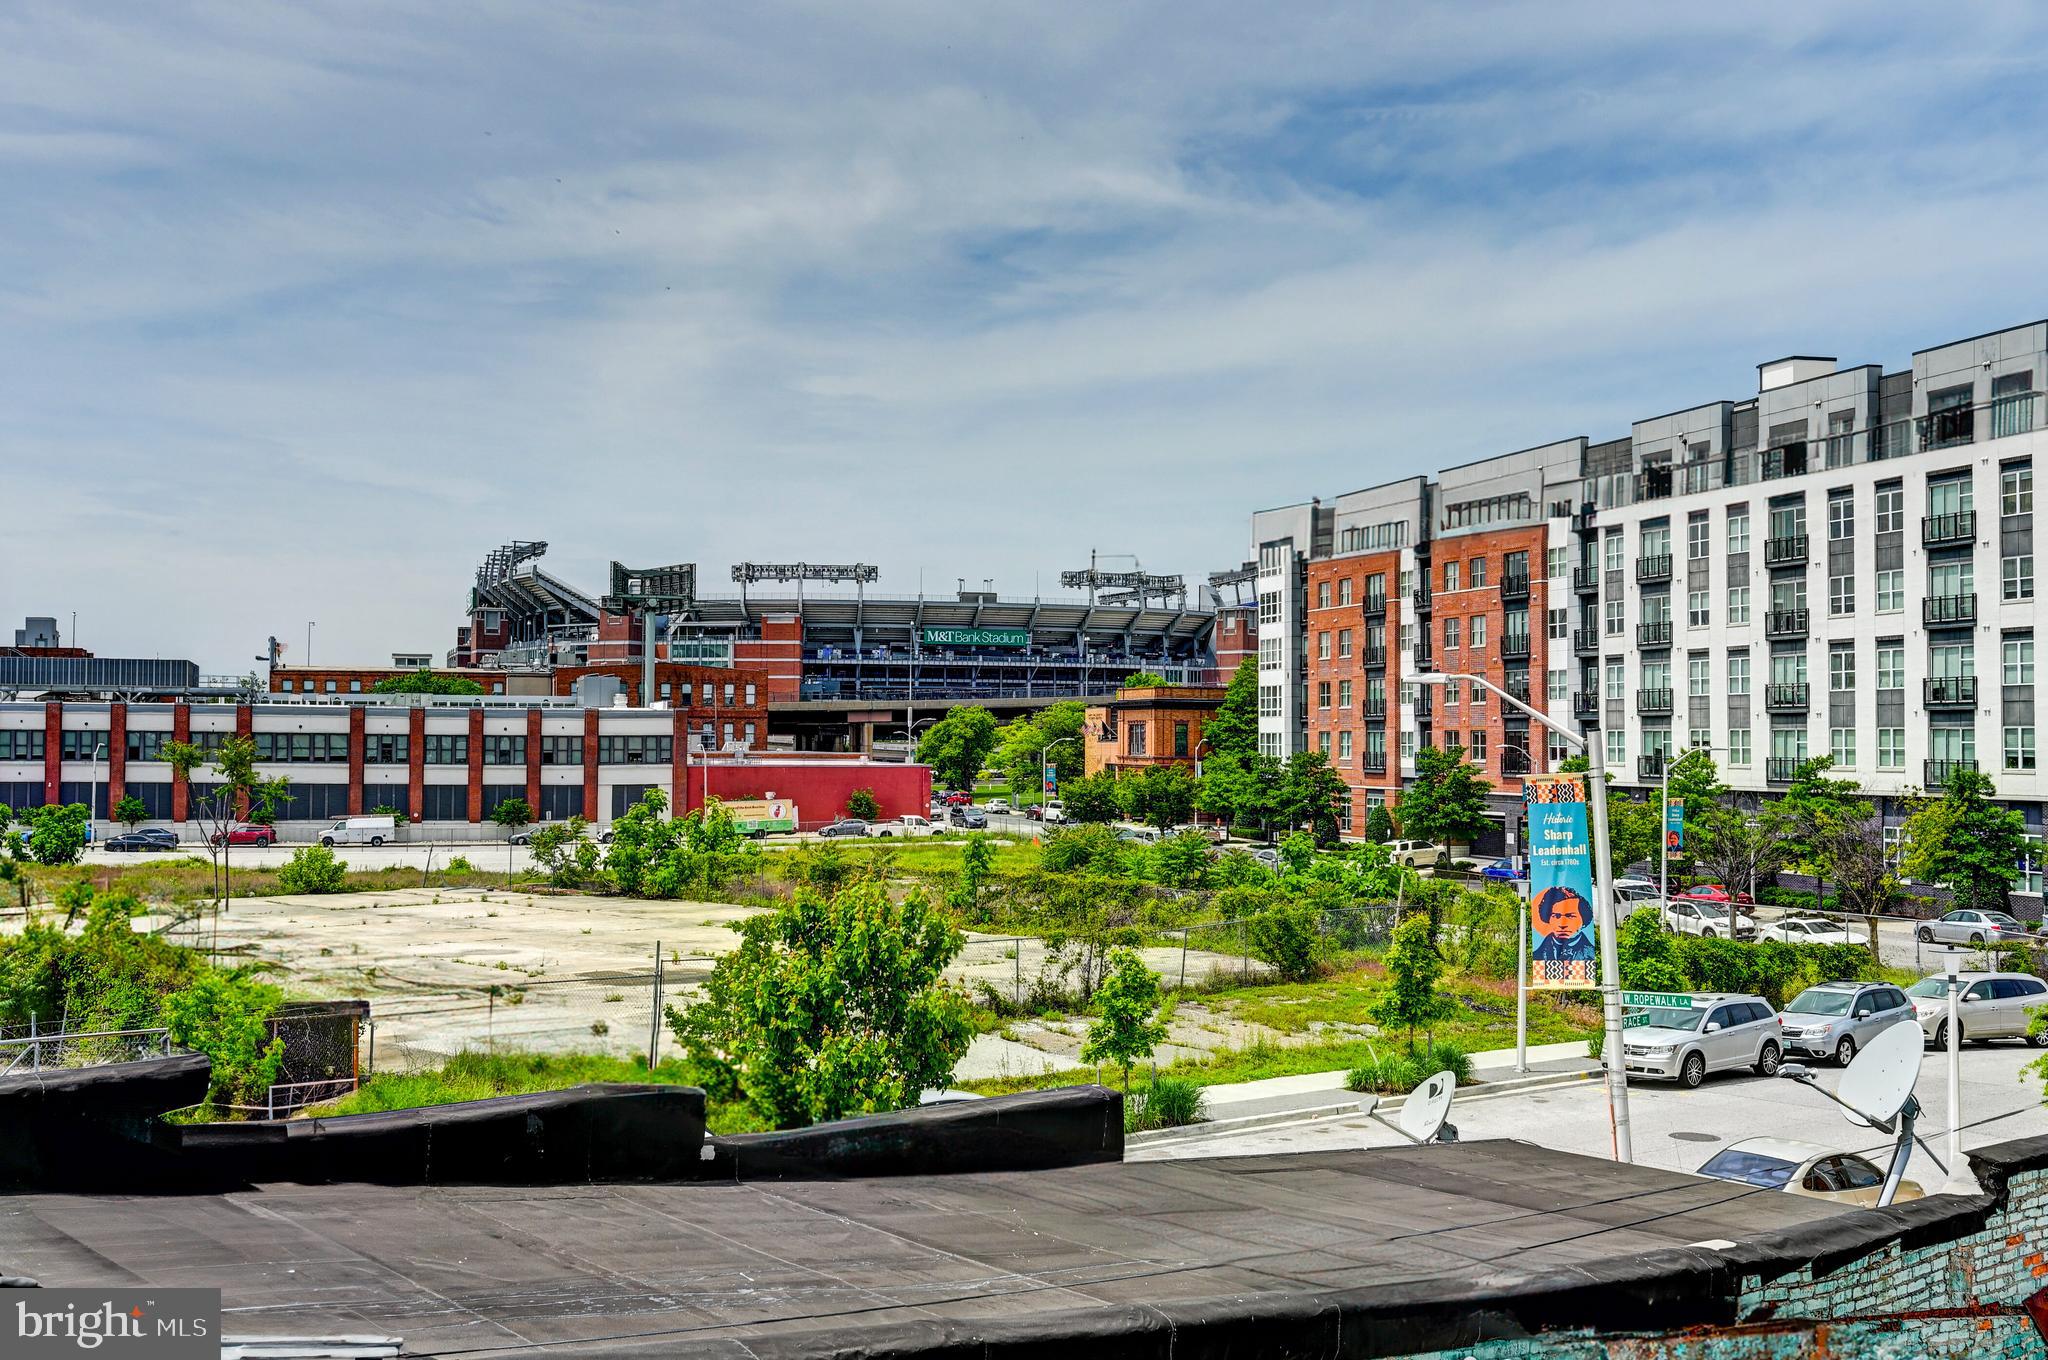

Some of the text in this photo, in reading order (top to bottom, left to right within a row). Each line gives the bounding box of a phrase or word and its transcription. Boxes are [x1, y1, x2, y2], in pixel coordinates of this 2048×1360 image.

[927, 631, 1024, 644] M&T Bank Stadium
[1543, 812, 1574, 825] Historic
[1544, 829, 1573, 842] Sharp
[1532, 844, 1586, 856] Leadenhall
[1634, 994, 1677, 1006] ROPEWALK
[1623, 1016, 1641, 1028] RACE
